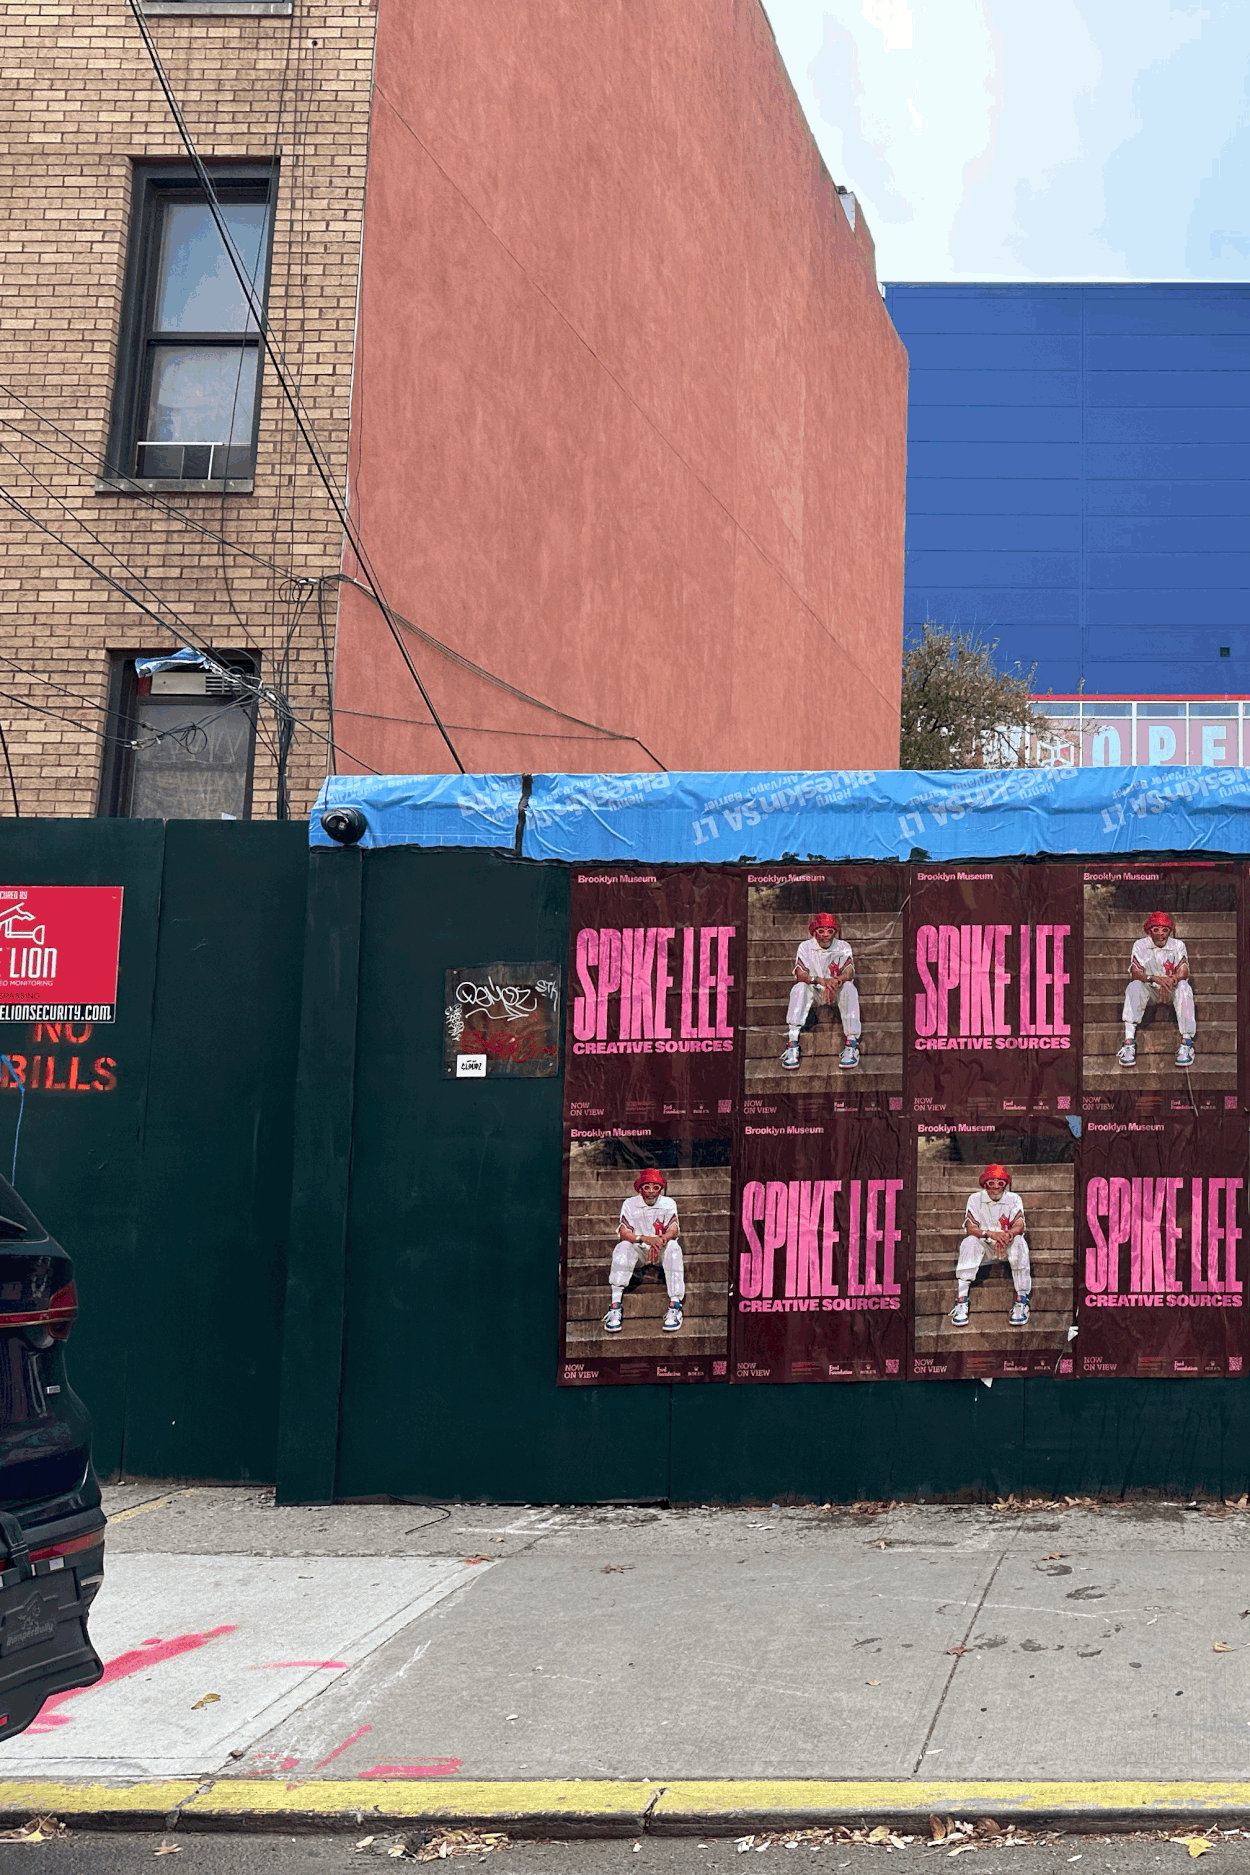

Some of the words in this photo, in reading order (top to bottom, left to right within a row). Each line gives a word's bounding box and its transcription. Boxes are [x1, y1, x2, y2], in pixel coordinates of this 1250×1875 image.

[815, 788, 851, 806] Henry
[1020, 782, 1055, 800] Henry
[578, 876, 618, 884] Brooklyn
[748, 875, 787, 884] Brooklyn
[918, 873, 955, 881] Brooklyn
[957, 872, 993, 880] Museum
[1084, 873, 1121, 881] Brooklyn
[10, 947, 58, 978] LION
[573, 928, 675, 1040] SPIKE
[681, 926, 736, 1038] LEE
[915, 924, 1012, 1036] SPIKE
[1019, 924, 1071, 1036] LEE
[572, 1040, 652, 1054] CREATIVE
[654, 1040, 734, 1053] SOURCES
[914, 1037, 992, 1050] CREATIVE
[995, 1036, 1071, 1050] SOURCES
[0, 1054, 118, 1092] BILLS
[571, 1129, 611, 1138] Brooklyn
[613, 1128, 651, 1136] Museum
[746, 1127, 785, 1135] Brooklyn
[918, 1124, 956, 1133] Brooklyn
[1088, 1123, 1126, 1132] Brooklyn
[739, 1180, 842, 1299] SPIKE
[848, 1179, 904, 1296] LEE
[1085, 1176, 1184, 1294] SPIKE
[1192, 1176, 1244, 1291] LEE
[738, 1298, 820, 1312] CREATIVE
[822, 1296, 900, 1311] SOURCES
[1084, 1294, 1164, 1308] CREATIVE
[1166, 1294, 1243, 1308] SOURCES
